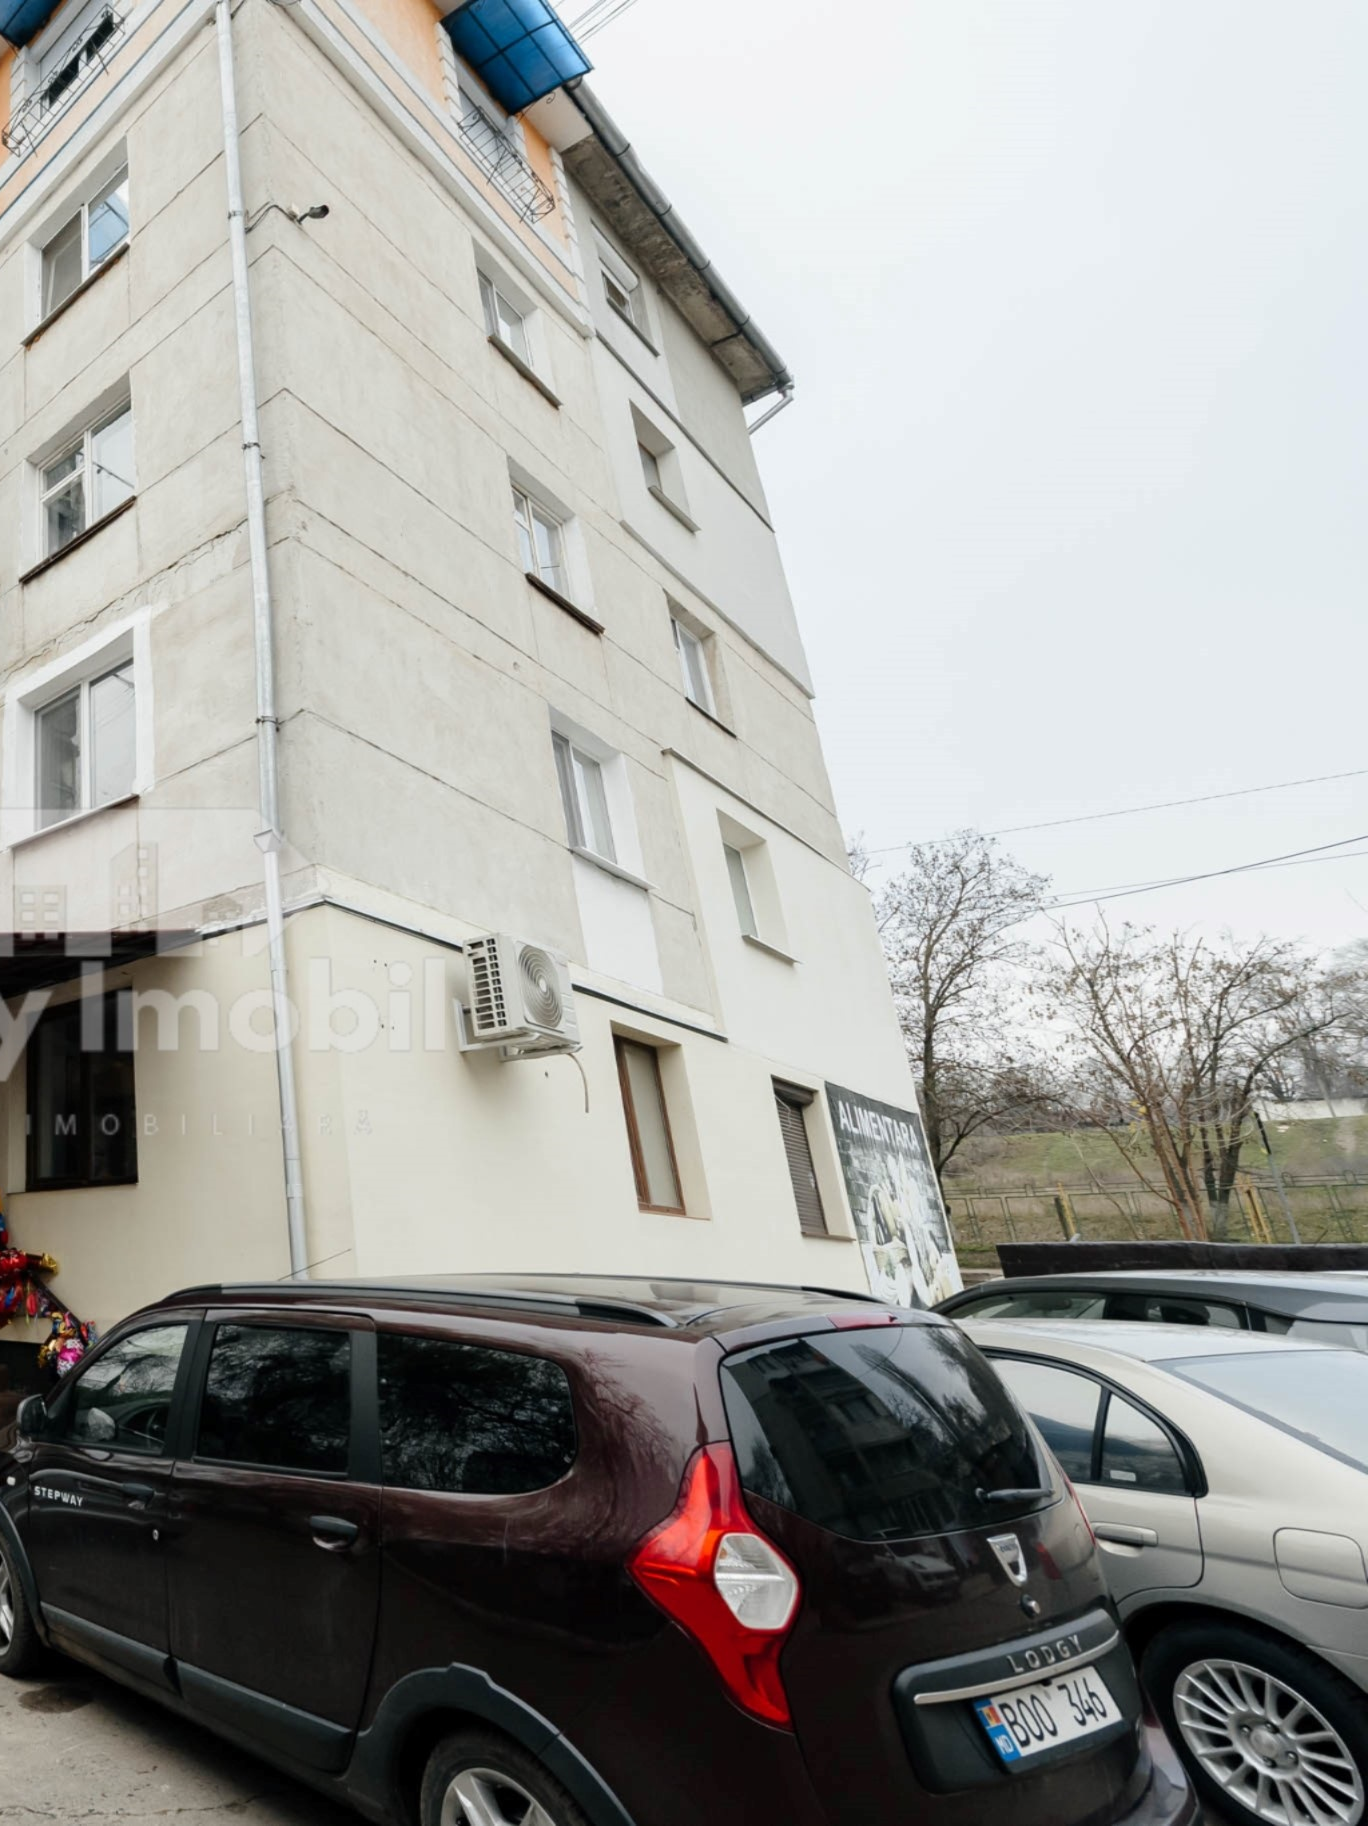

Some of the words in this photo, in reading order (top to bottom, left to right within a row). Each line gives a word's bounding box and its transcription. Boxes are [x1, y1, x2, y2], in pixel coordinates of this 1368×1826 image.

[837, 1100, 921, 1151] ALIMENTARA
[34, 1485, 83, 1507] STEPWAY
[1006, 1634, 1082, 1673] LODGY
[994, 1735, 1012, 1754] MD
[1057, 1677, 1107, 1727] 346
